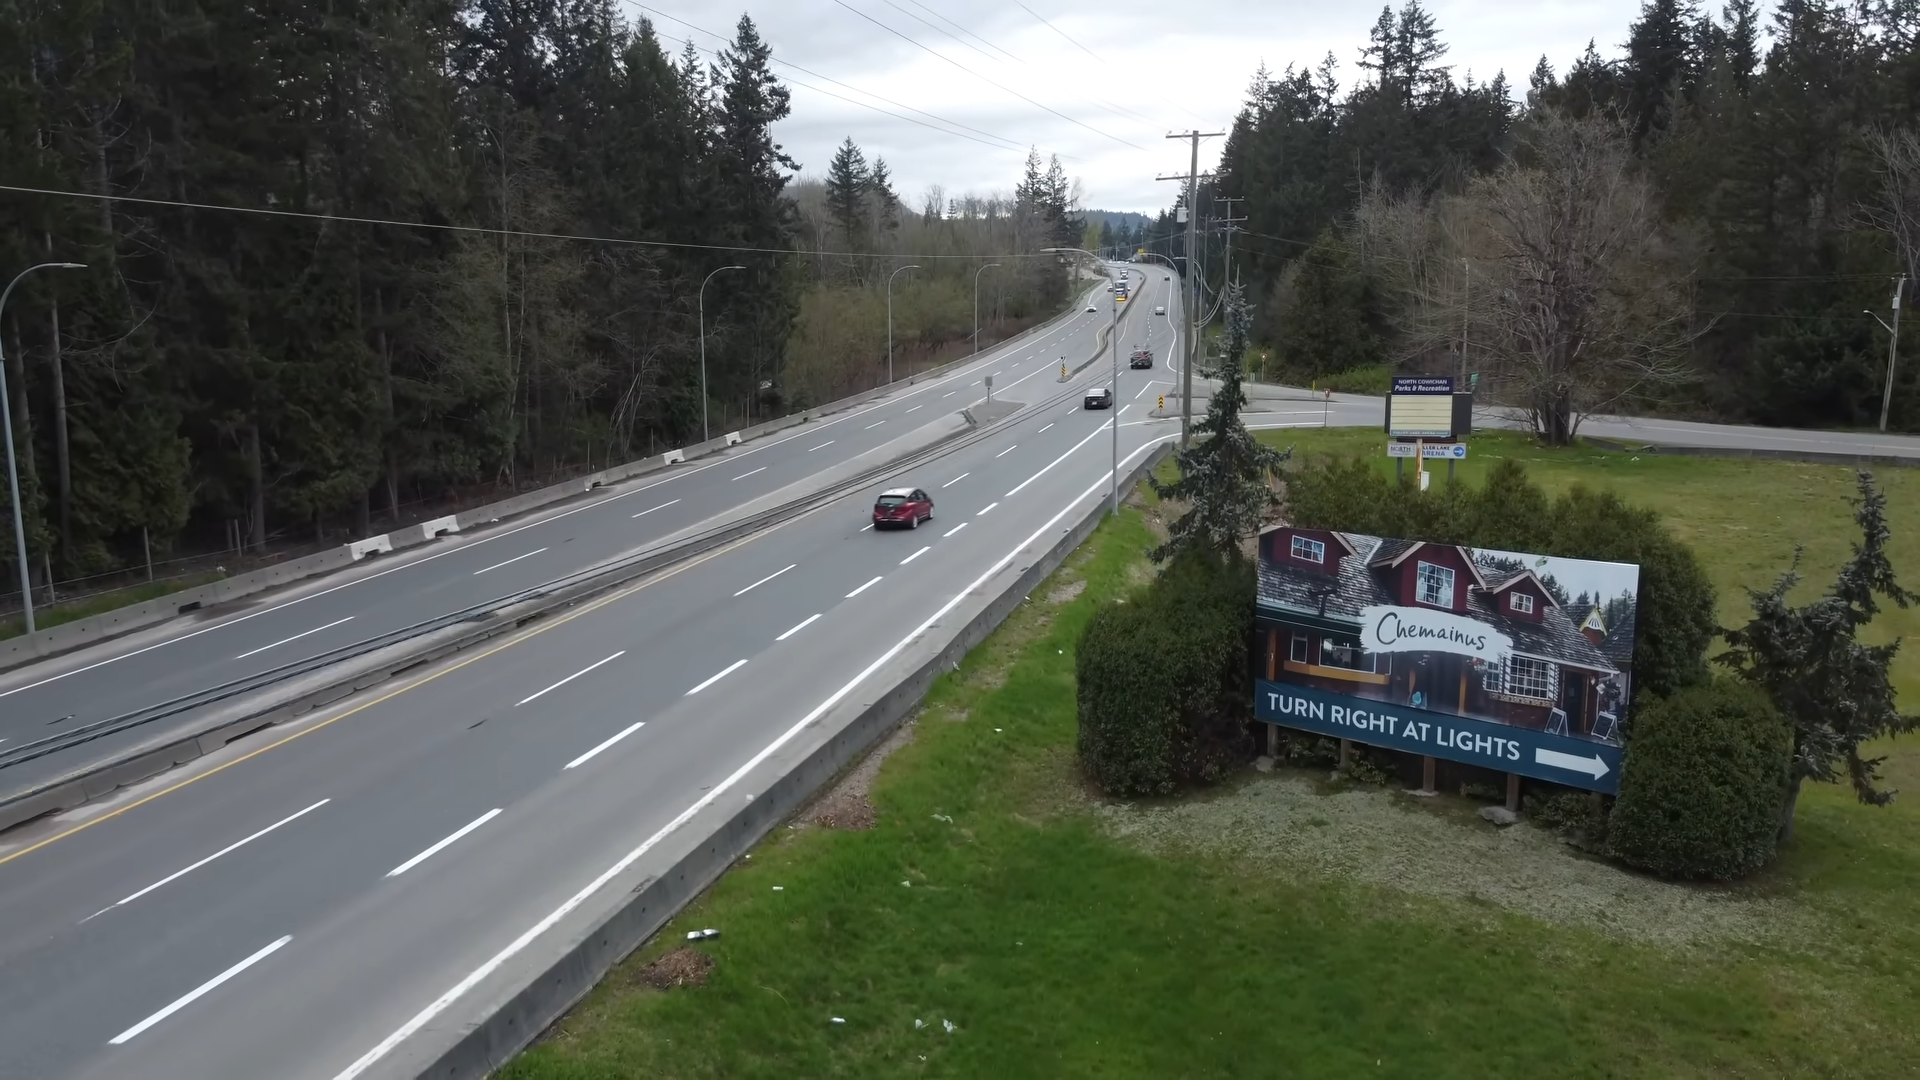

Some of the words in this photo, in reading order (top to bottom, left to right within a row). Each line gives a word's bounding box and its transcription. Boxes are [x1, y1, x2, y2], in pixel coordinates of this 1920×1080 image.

[1376, 611, 1487, 651] Chemainus
[1267, 692, 1324, 720] TURN
[1331, 705, 1398, 735] RIGHT
[1402, 720, 1431, 741] AT
[1436, 726, 1521, 760] LIGHTS
